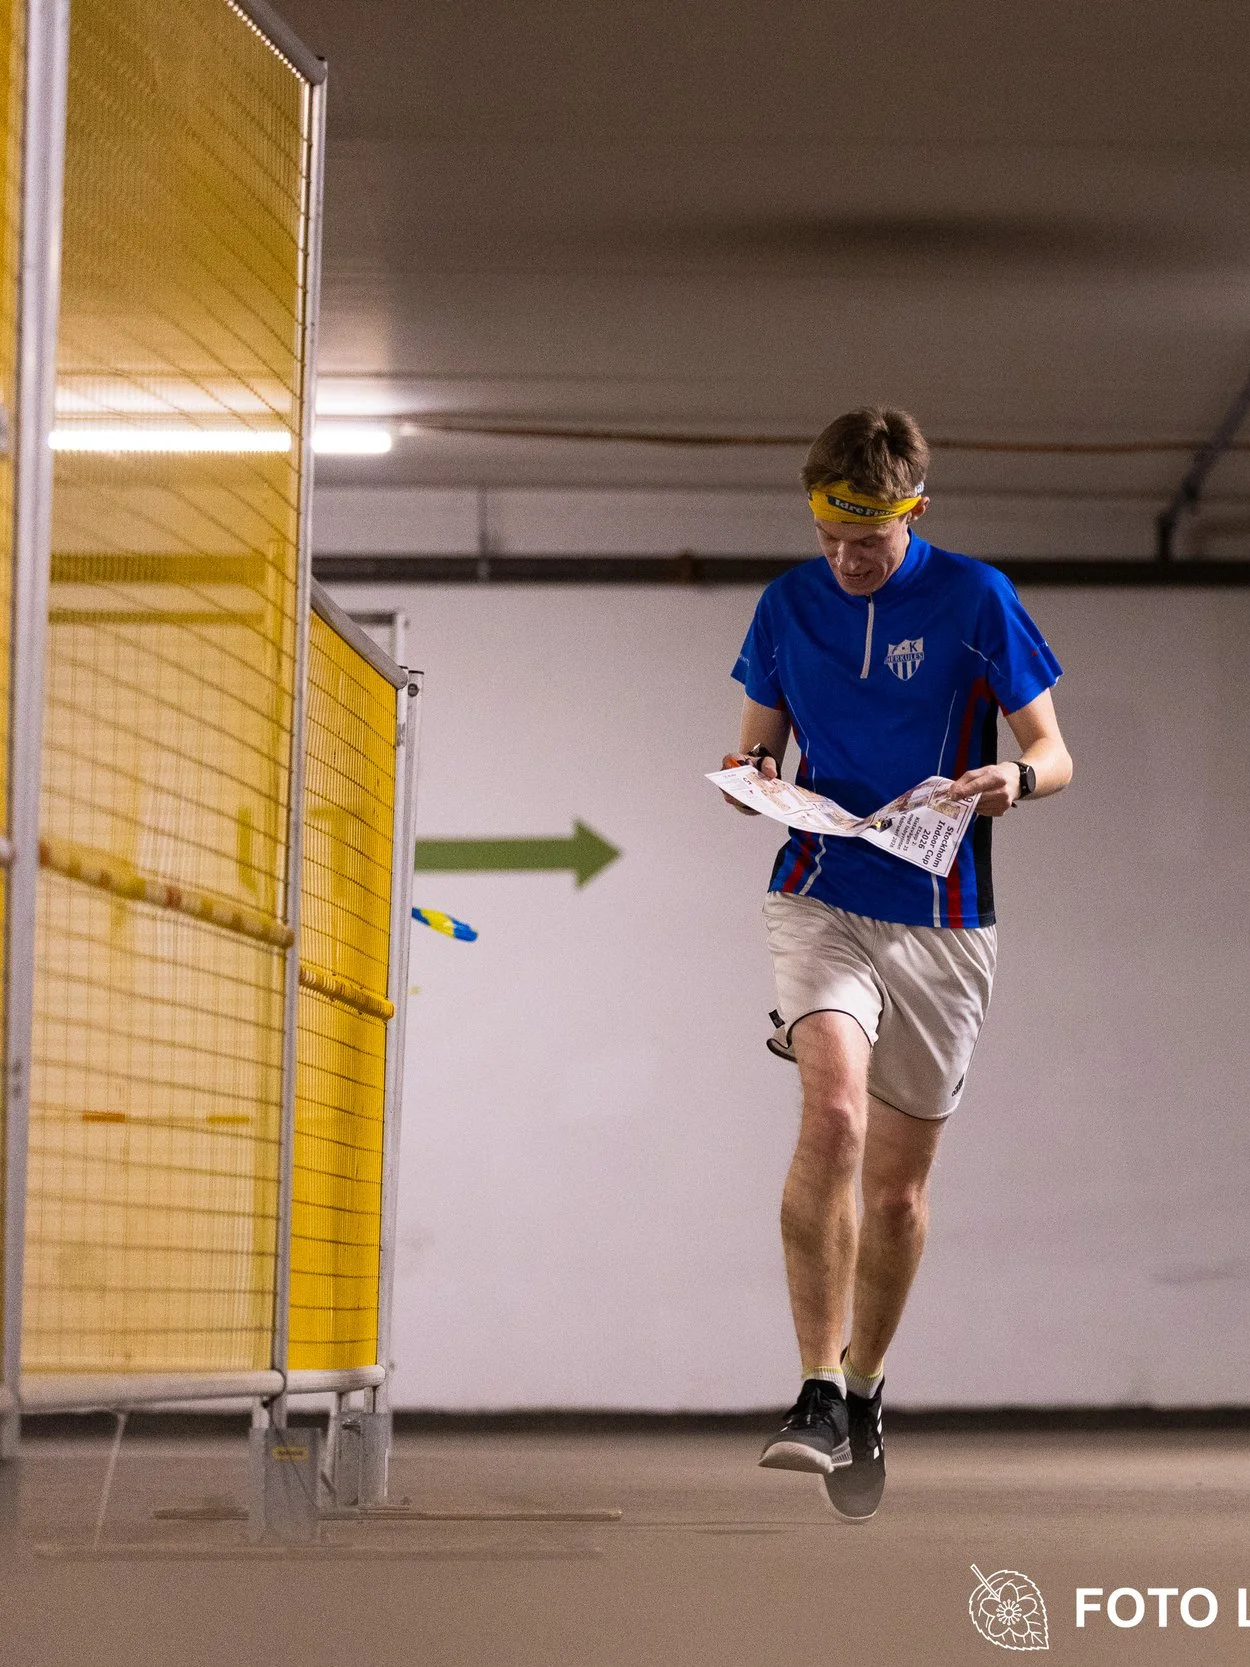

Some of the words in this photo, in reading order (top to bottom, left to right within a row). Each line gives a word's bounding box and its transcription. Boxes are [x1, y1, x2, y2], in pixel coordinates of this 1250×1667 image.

[913, 826, 923, 840] Etapp
[918, 829, 931, 849] 2026
[930, 820, 945, 848] Indoor
[923, 849, 934, 865] Cup
[933, 826, 954, 868] Stockholm
